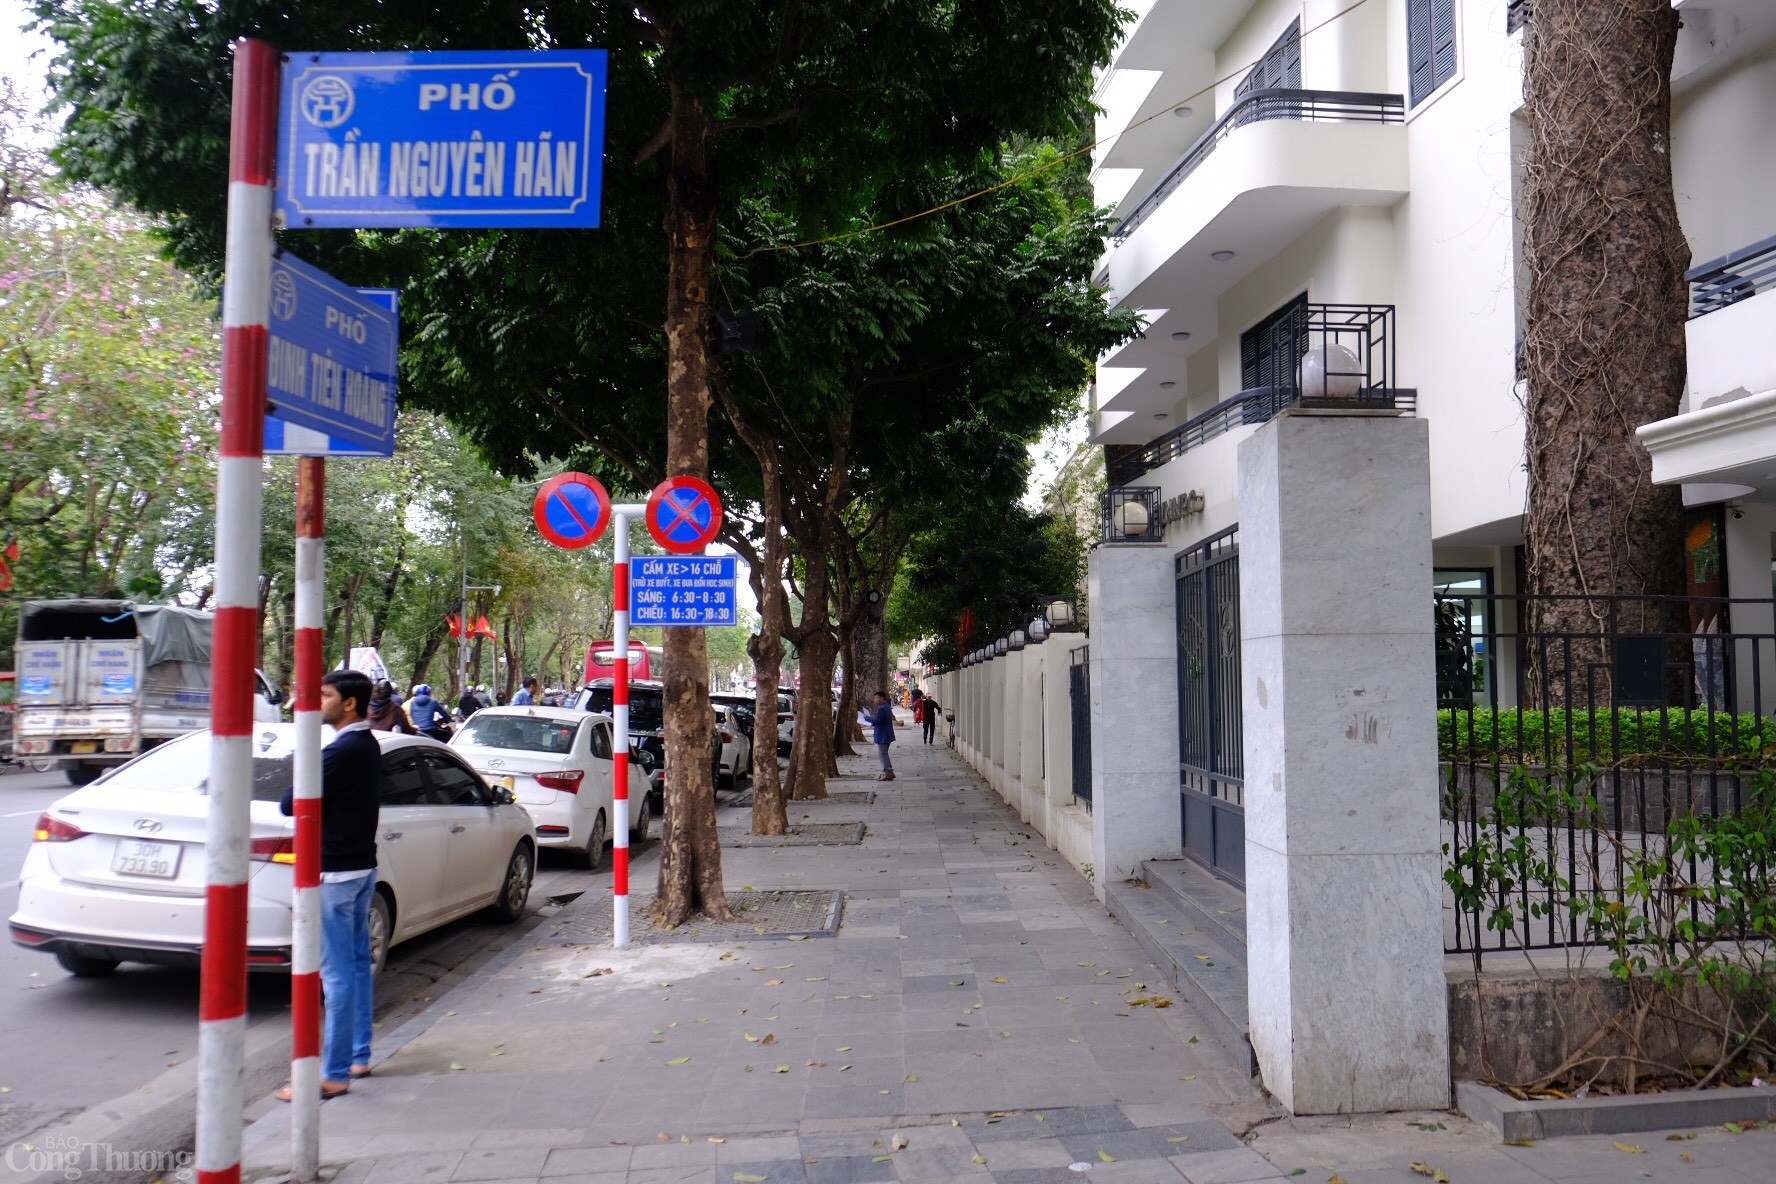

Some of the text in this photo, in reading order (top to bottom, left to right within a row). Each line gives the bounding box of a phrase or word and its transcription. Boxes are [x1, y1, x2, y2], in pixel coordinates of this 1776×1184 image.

[418, 70, 520, 111] PHỐ
[304, 127, 577, 197] TRẦN NGUYÊN HÃN
[325, 305, 367, 344] PHỐ
[268, 334, 308, 398] ĐINH
[311, 348, 344, 411] TIÊN
[643, 559, 664, 575] CẤM
[703, 559, 722, 575] CHỖ
[647, 579, 655, 587] XE
[673, 579, 680, 587] XE
[637, 589, 666, 603] SÁNG:
[637, 604, 667, 620] CHIỀU:
[134, 842, 161, 857] 30H
[119, 856, 169, 875] 733.90
